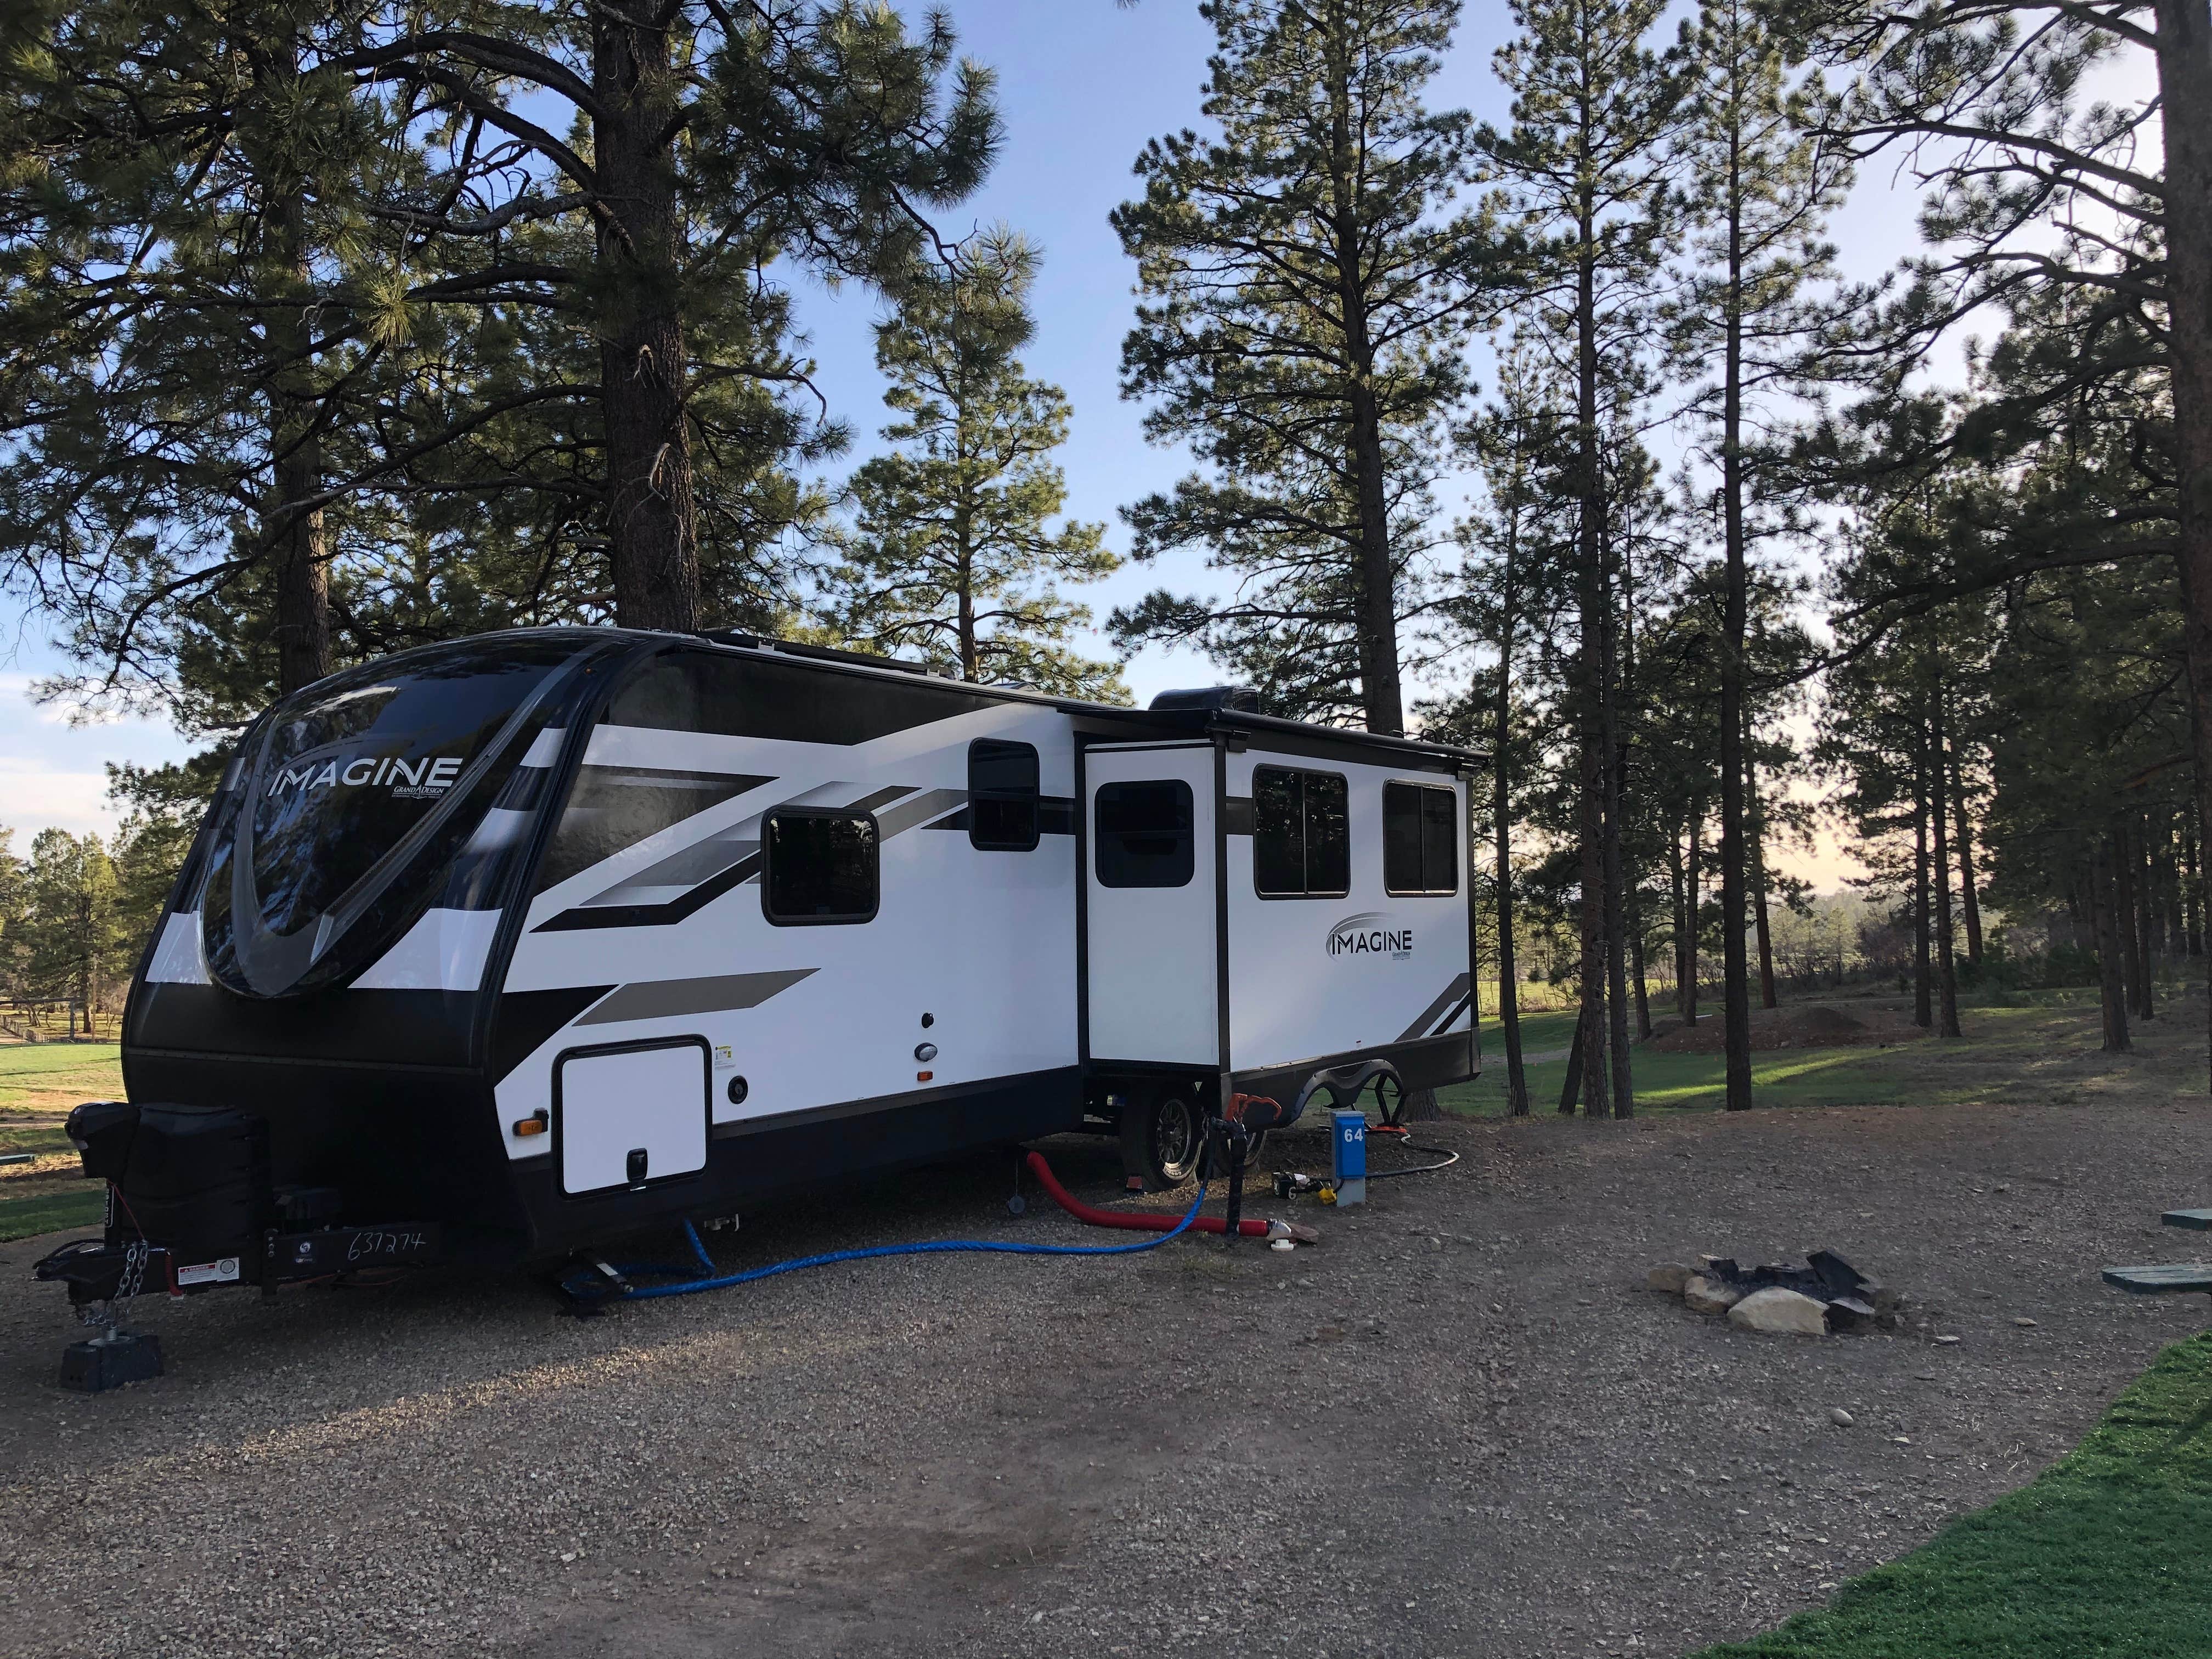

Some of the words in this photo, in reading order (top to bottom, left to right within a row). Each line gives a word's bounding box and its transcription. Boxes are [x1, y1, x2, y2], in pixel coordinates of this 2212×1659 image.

[268, 758, 463, 797] IMAGINE
[1332, 930, 1412, 955] IMAGINE
[1344, 1128, 1363, 1142] 64
[347, 1232, 426, 1261] 637274
